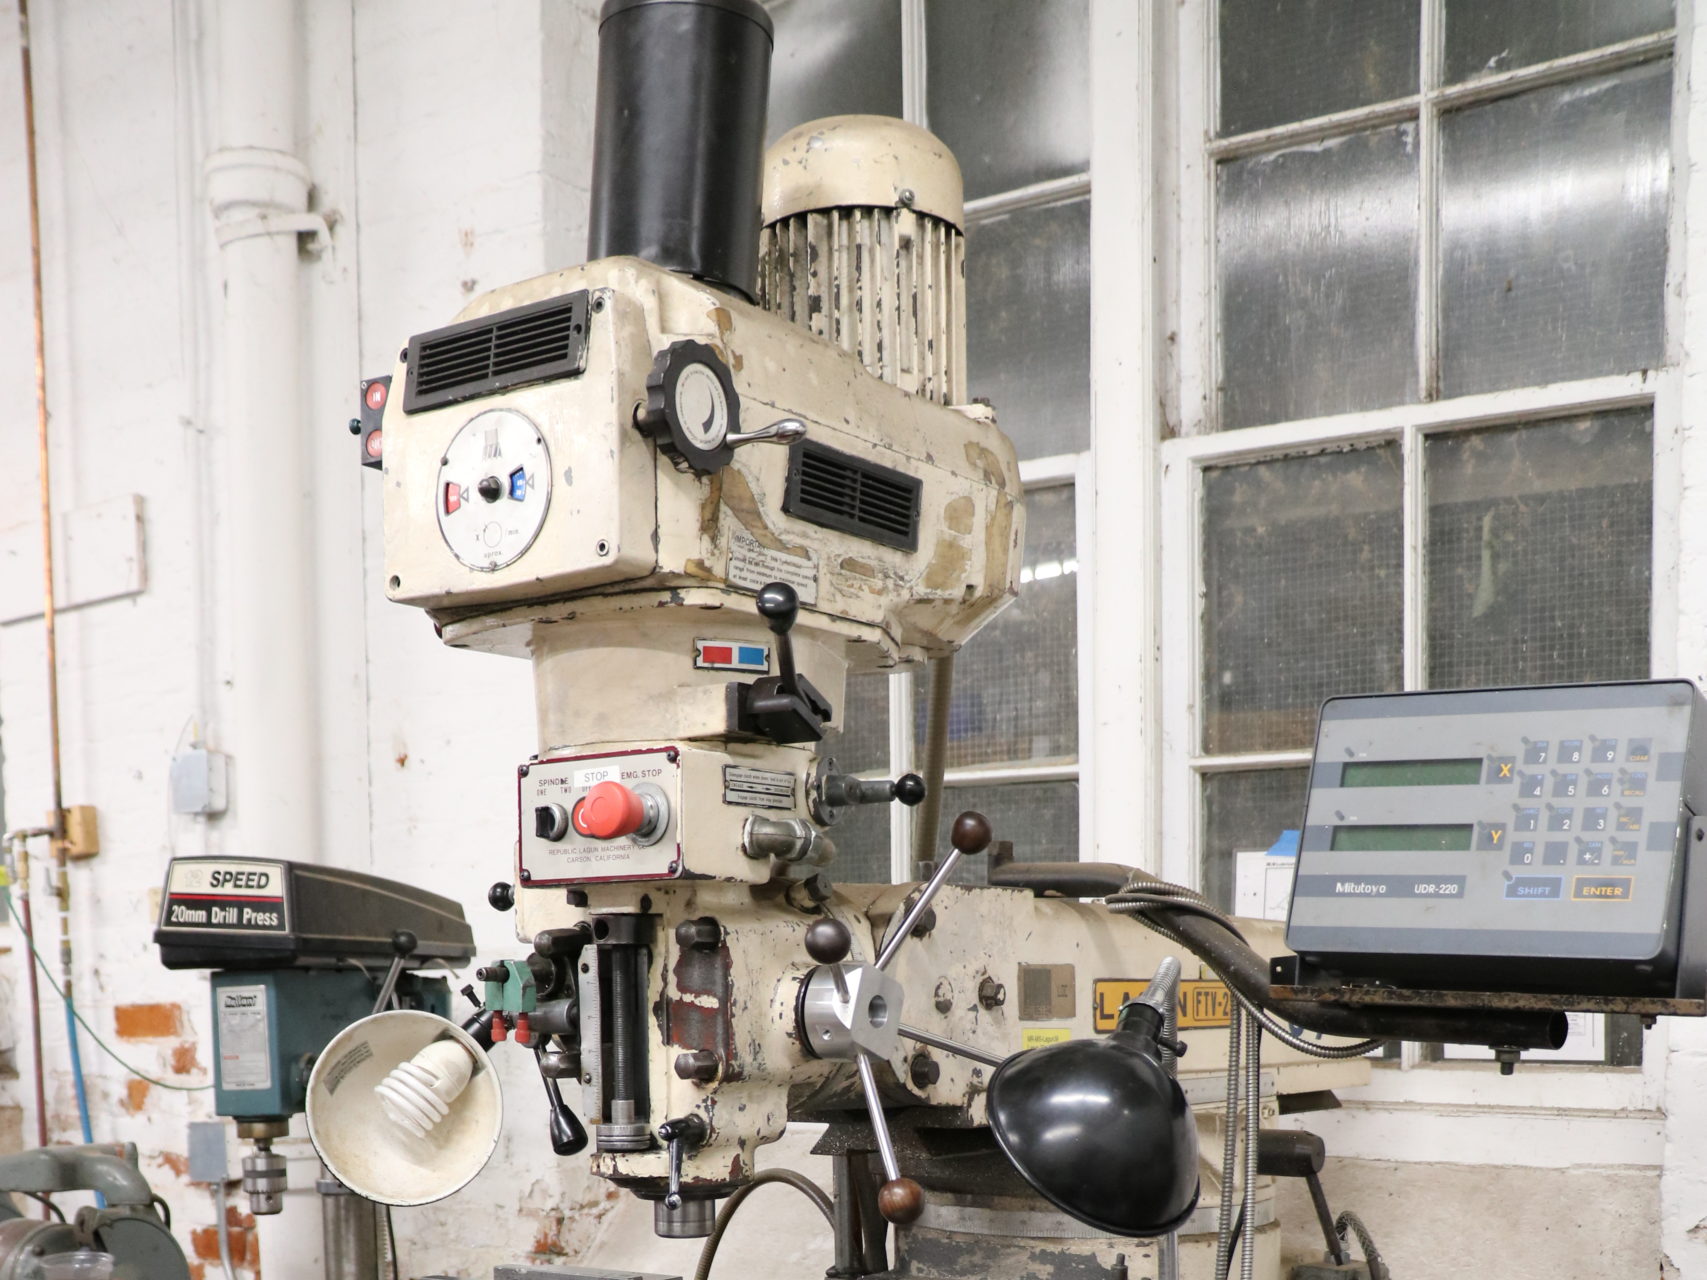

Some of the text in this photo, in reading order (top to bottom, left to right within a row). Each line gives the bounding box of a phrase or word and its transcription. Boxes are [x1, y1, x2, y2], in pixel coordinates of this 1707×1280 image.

[1538, 753, 1546, 762] 7
[1572, 752, 1580, 762] 8
[1606, 751, 1614, 761] 9
[1499, 763, 1512, 777] X
[584, 770, 609, 783] STOP
[641, 769, 663, 778] STOP
[1533, 786, 1541, 795] 4
[1568, 785, 1575, 795] 5
[1602, 784, 1609, 795] 6
[1563, 820, 1570, 829] 2
[1597, 820, 1604, 829] 3
[1491, 830, 1502, 844] Y
[594, 853, 631, 862] CALIFORNIA
[1524, 853, 1531, 863] 0
[210, 870, 270, 889] SPEED
[1335, 882, 1458, 896] Mitutoyo UDR-220
[1517, 887, 1623, 896] SHIFT ENTER
[171, 905, 279, 926] 20mm Drill Press
